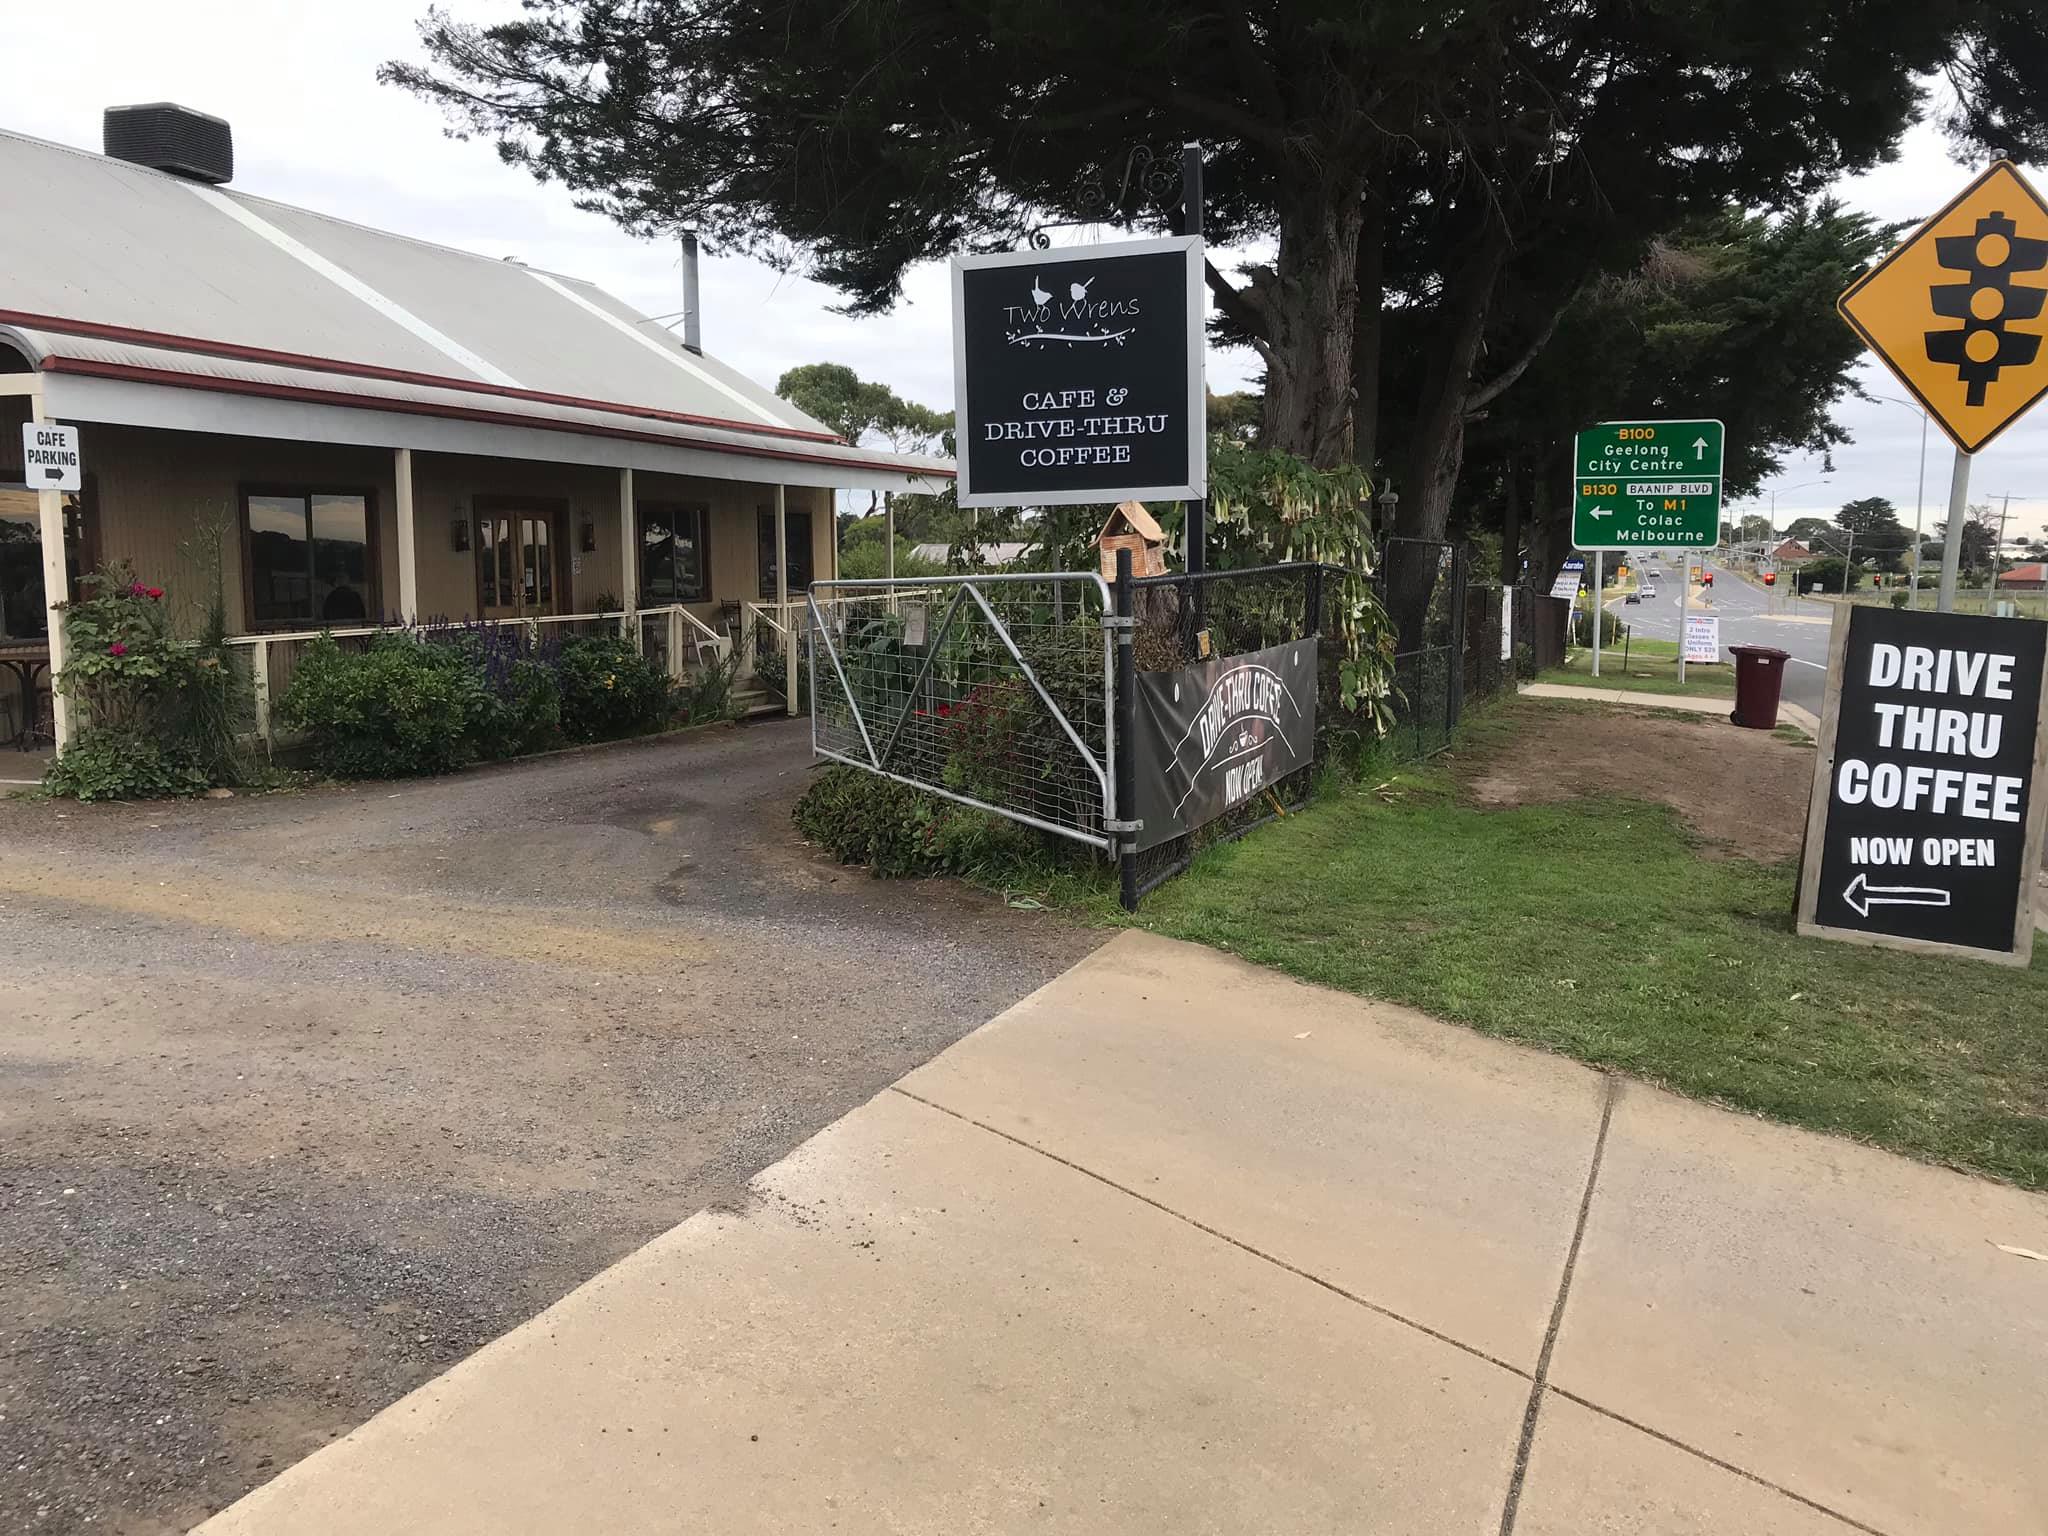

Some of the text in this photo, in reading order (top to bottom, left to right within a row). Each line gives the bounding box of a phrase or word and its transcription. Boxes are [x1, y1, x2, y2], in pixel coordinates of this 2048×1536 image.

[1003, 297, 1142, 325] Two Wrens
[1022, 387, 1129, 411] CAFE &
[984, 414, 1169, 441] DRIVE-THRU
[1619, 428, 1655, 440] B100
[37, 431, 66, 447] CAFE
[27, 449, 77, 466] PARKING
[1020, 445, 1131, 467] COFFEE
[1604, 444, 1669, 457] Geelong
[1588, 459, 1684, 473] City Centre
[1582, 484, 1709, 496] B130 BAANIP BLVD
[1636, 499, 1654, 511] To
[1638, 515, 1683, 526] Colac
[1616, 530, 1704, 541] Melbourne
[1868, 642, 2016, 700] DRIVE
[1199, 671, 1252, 760] DRIVE-THRU
[1874, 702, 2003, 759] THRU
[1225, 764, 1245, 808] NOW
[1838, 759, 2023, 823] COFFEE
[1850, 837, 1995, 867] NOW OPEN
